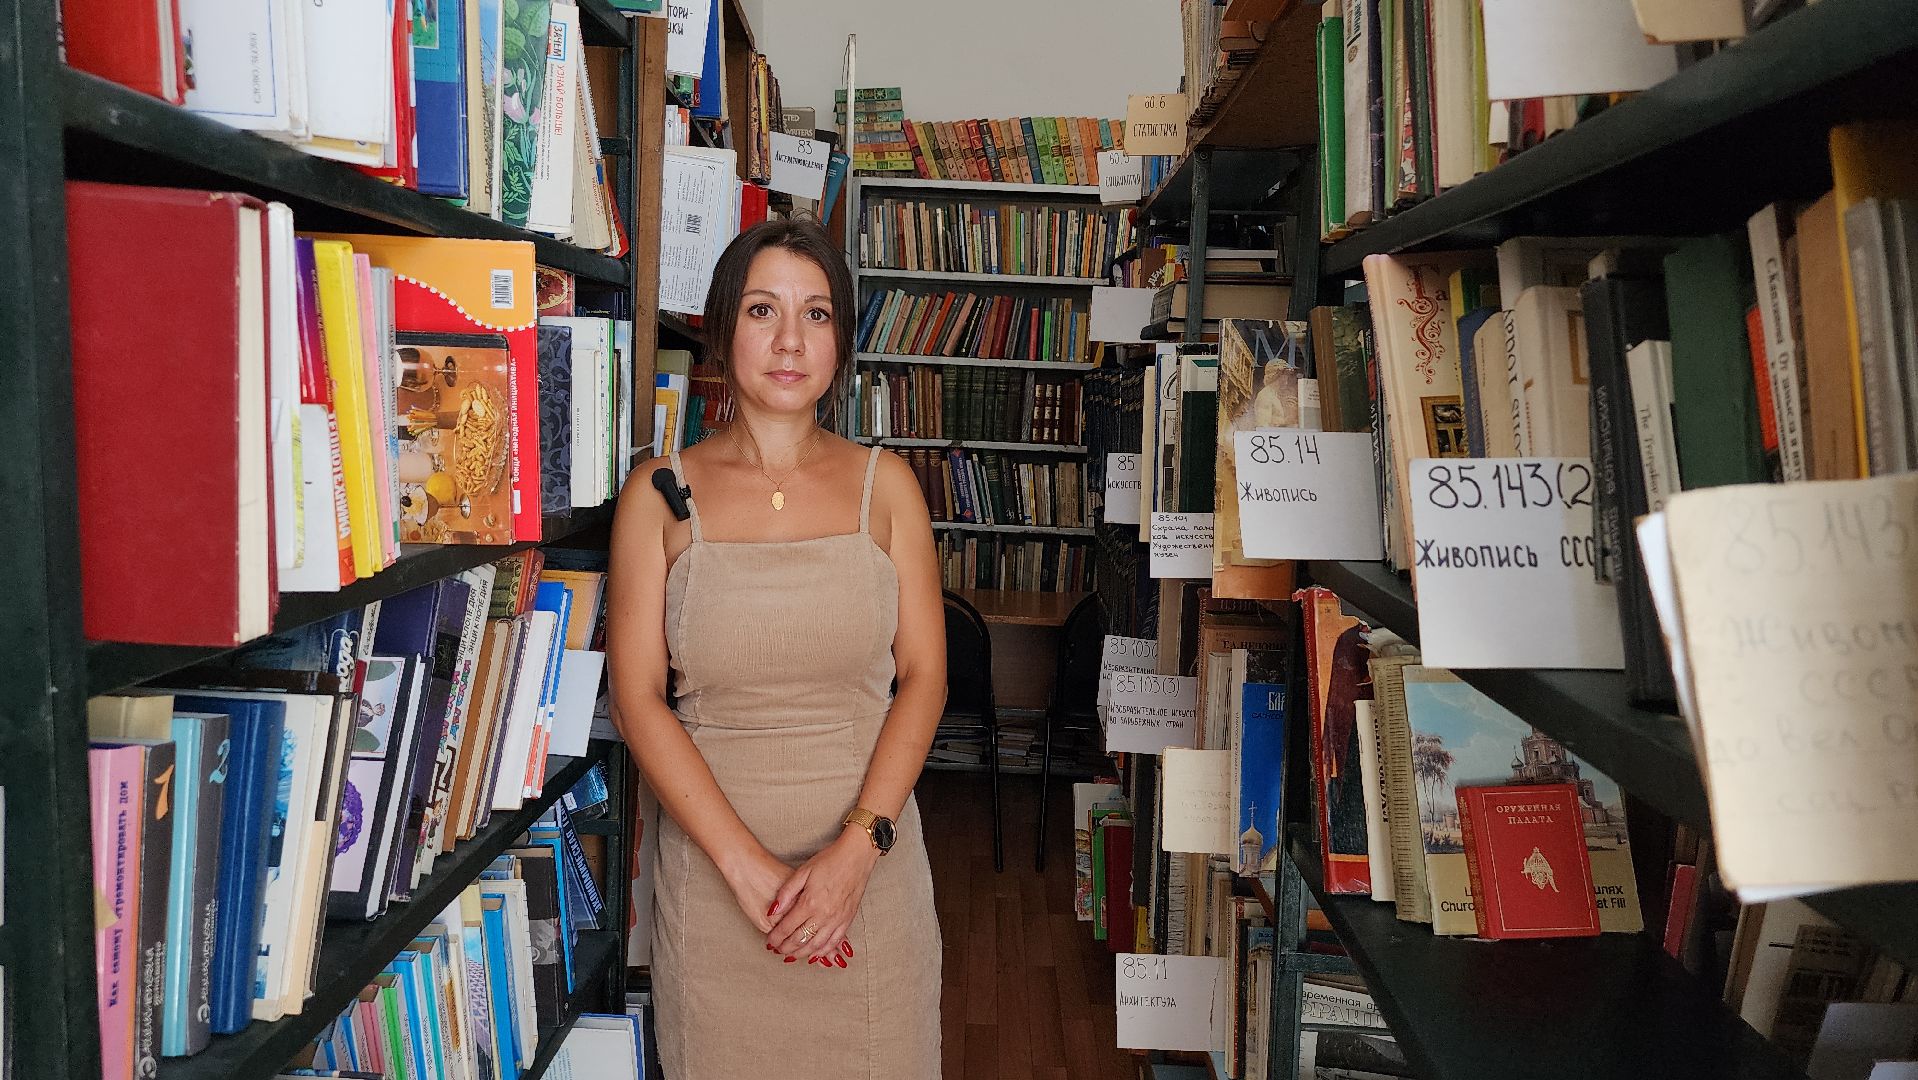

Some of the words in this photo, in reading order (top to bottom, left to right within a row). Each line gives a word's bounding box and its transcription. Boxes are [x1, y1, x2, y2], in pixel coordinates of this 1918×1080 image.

[553, 26, 563, 58] ЗАЧЕМ
[556, 65, 566, 95] УЗНАЙ
[554, 96, 566, 136] БОЛЬШЕ!
[1133, 123, 1178, 137] СТАТИСТИКА
[797, 139, 813, 155] 83
[510, 358, 520, 411] ИНИЦИАТИВА»
[511, 412, 521, 456] «НАРОДНАЯ
[1117, 455, 1135, 471] 85
[1250, 434, 1321, 465] 85.14
[511, 457, 522, 483] ФОНДА
[1107, 478, 1142, 490] ИСКУССТВ
[1240, 481, 1318, 502] Живопись
[1428, 462, 1593, 510] 85.143(2
[1151, 524, 1188, 533] Охрана
[1724, 496, 1911, 573] 85.143
[1415, 539, 1539, 569] Живопись
[209, 738, 231, 784] 2
[119, 780, 130, 806] дом
[153, 764, 174, 821] 1
[1496, 803, 1561, 813] ОРУЖЕЙНАЯ
[1507, 815, 1554, 825] ПАЛАТА
[565, 829, 604, 914] ЭКОНОМИЧЕСКАЯ
[1610, 898, 1627, 909] Fili
[110, 927, 124, 973] самому
[1122, 956, 1167, 980] 85.11
[108, 979, 120, 1008] Как
